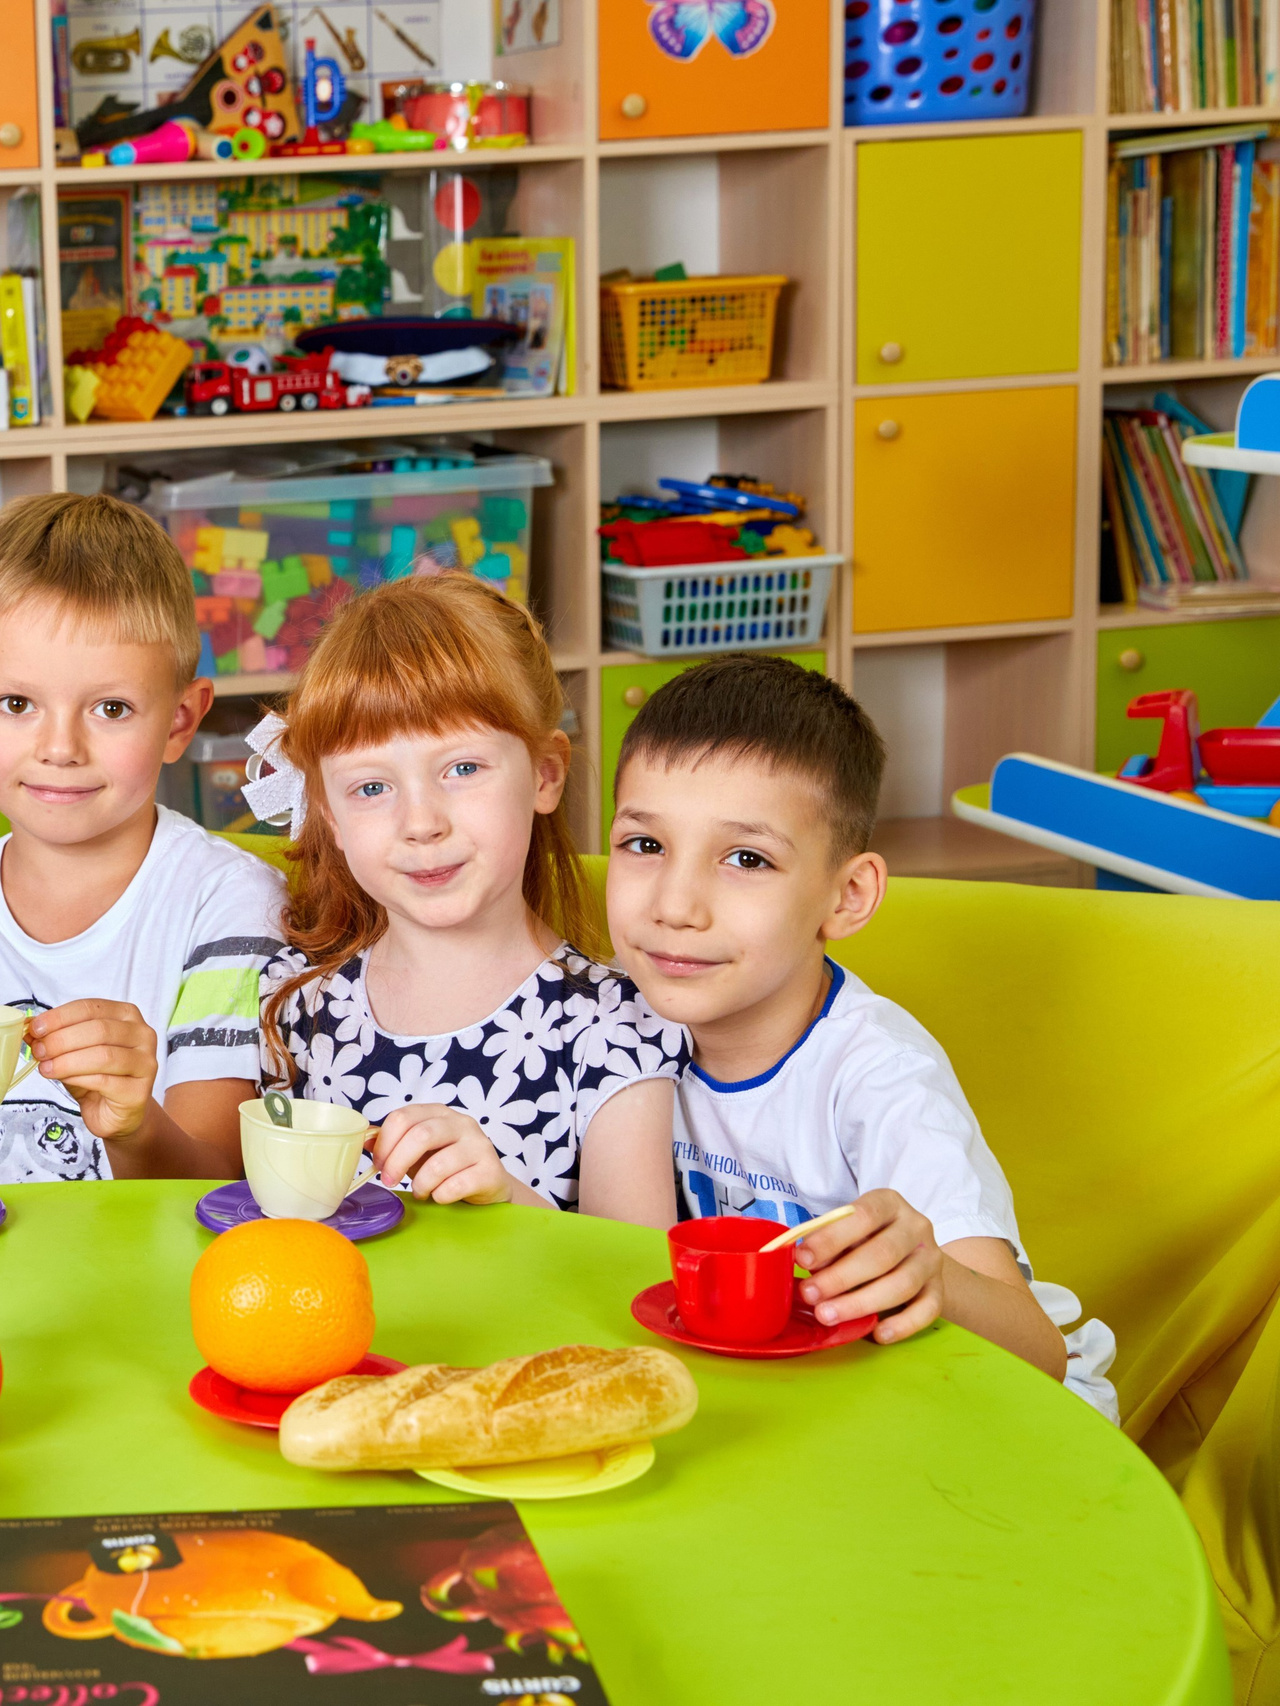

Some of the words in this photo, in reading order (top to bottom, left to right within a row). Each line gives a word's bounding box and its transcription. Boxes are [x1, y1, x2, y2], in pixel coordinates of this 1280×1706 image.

[673, 1141, 700, 1162] THE
[744, 1172, 799, 1198] WORLD
[482, 1675, 582, 1697] CURTIS
